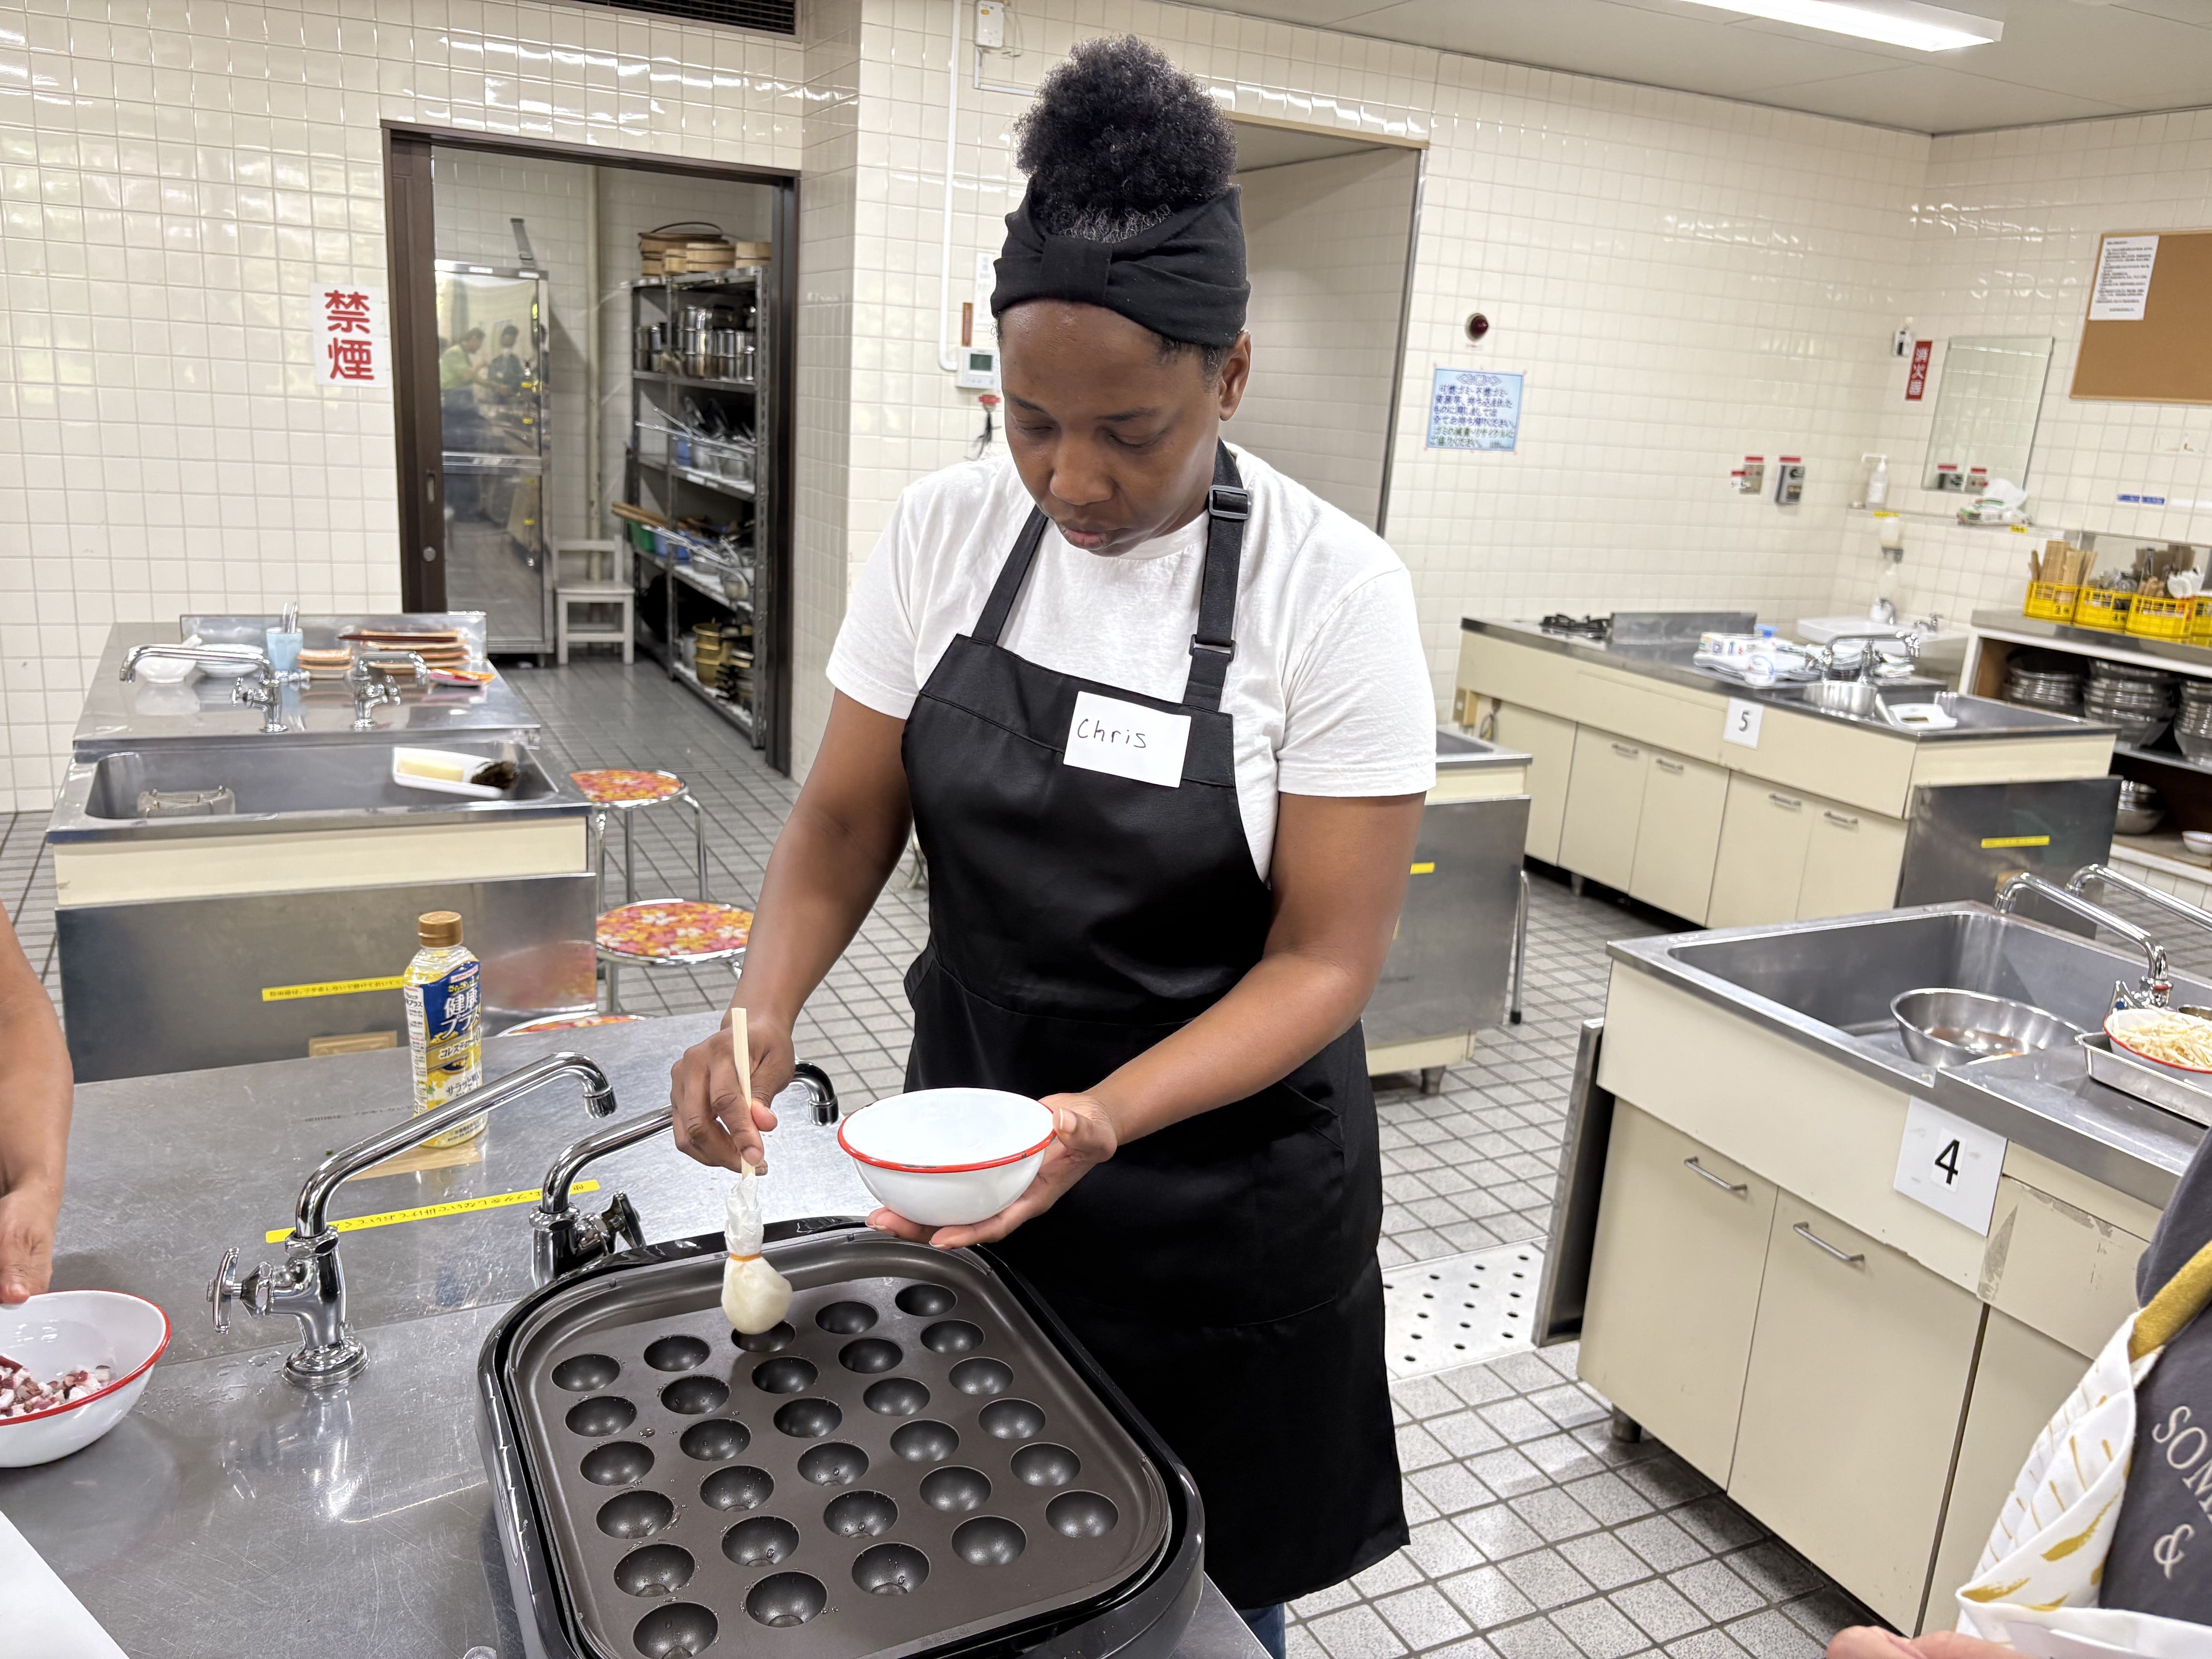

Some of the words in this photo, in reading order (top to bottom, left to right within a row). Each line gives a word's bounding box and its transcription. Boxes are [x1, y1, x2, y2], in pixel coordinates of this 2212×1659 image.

[325, 290, 374, 381] 禁煙
[1908, 347, 1929, 395] 消火器
[1077, 718, 1147, 748] Chris
[1739, 709, 1751, 732] 5
[441, 1005, 480, 1039] プラス
[444, 988, 478, 1019] 健康
[1934, 1138, 1960, 1185] 4
[2152, 1405, 2212, 1524] SOM
[2153, 1523, 2195, 1579] &
